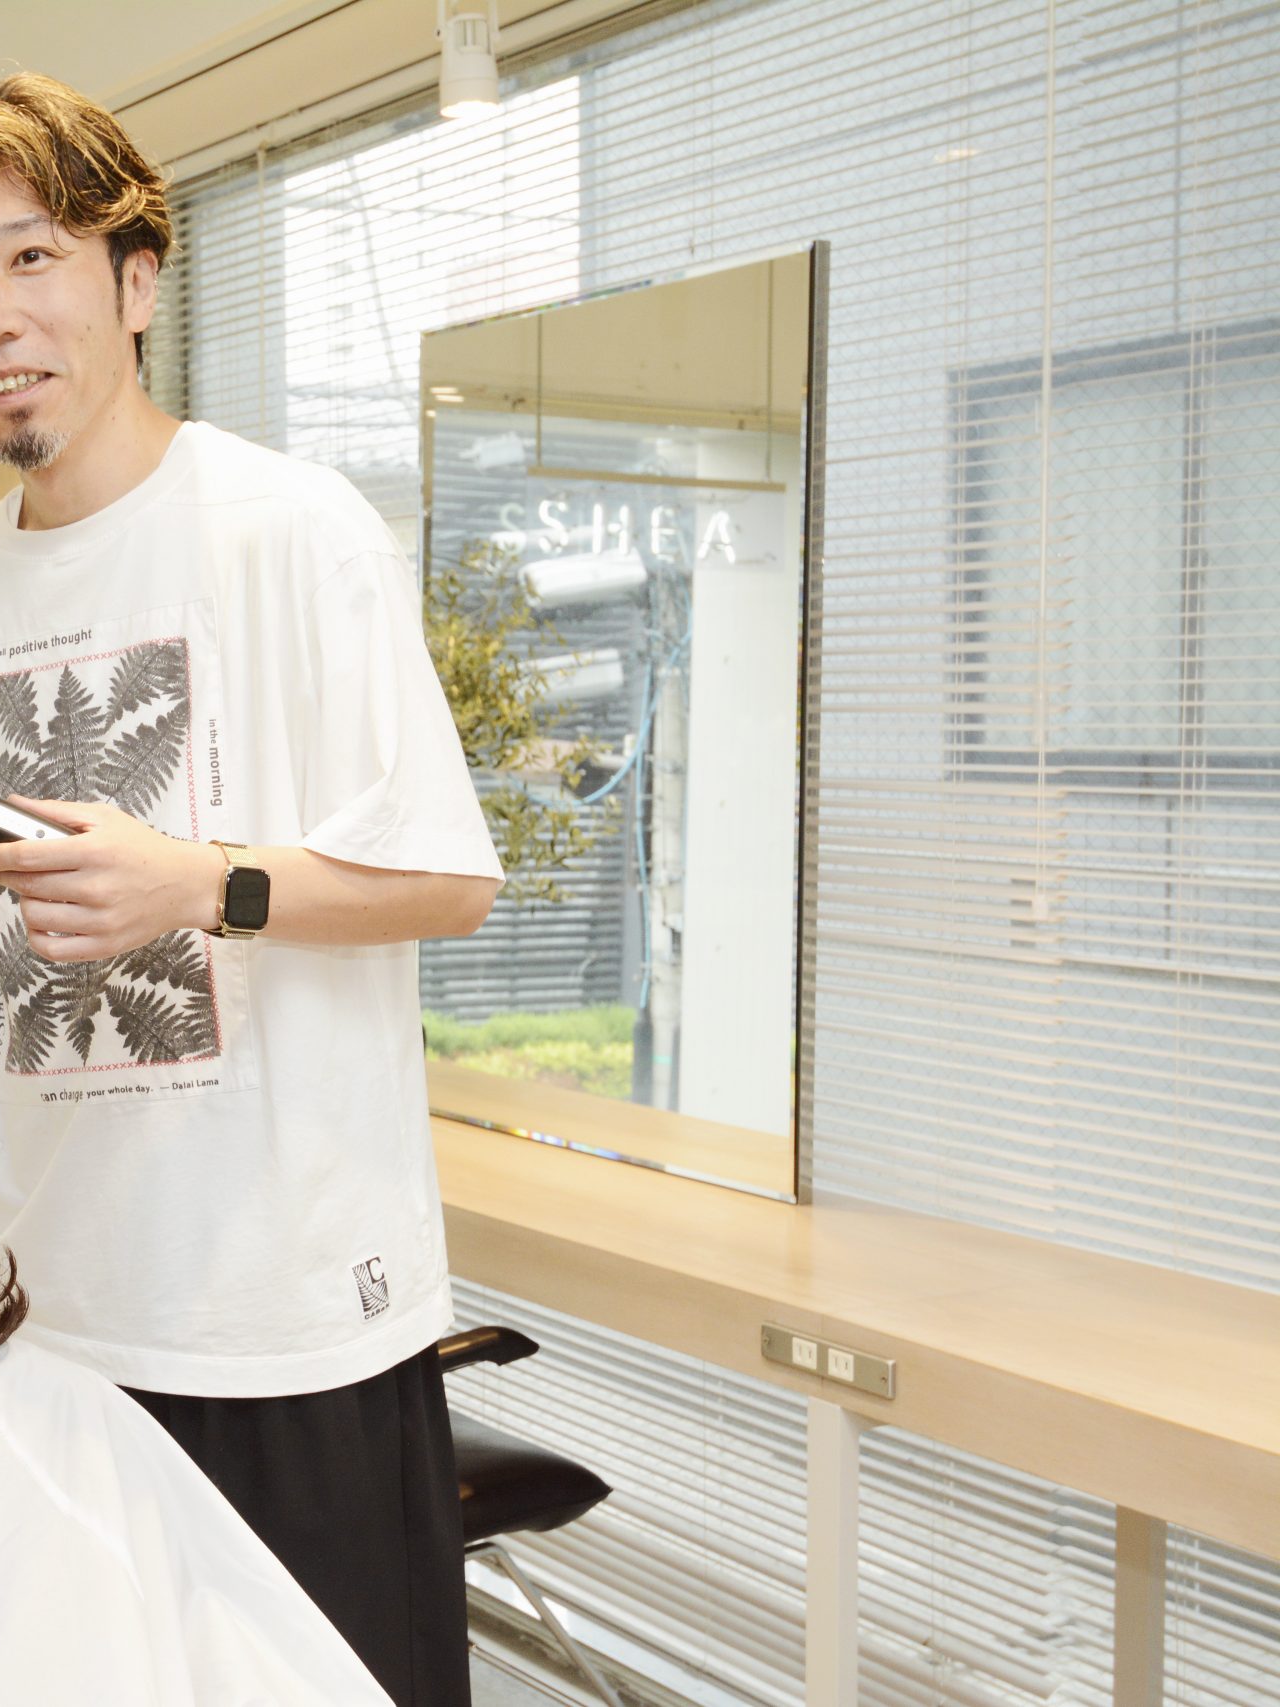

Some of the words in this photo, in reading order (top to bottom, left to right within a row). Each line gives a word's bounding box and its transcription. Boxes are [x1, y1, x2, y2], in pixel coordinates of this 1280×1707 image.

[9, 640, 48, 658] positive
[51, 628, 92, 647] thought
[209, 719, 216, 727] in
[210, 729, 218, 744] the
[209, 747, 224, 807] morning
[86, 1089, 106, 1100] your
[107, 1085, 133, 1095] whole
[135, 1084, 154, 1095] day.
[172, 1080, 194, 1091] Dalai
[197, 1078, 219, 1088] Lama
